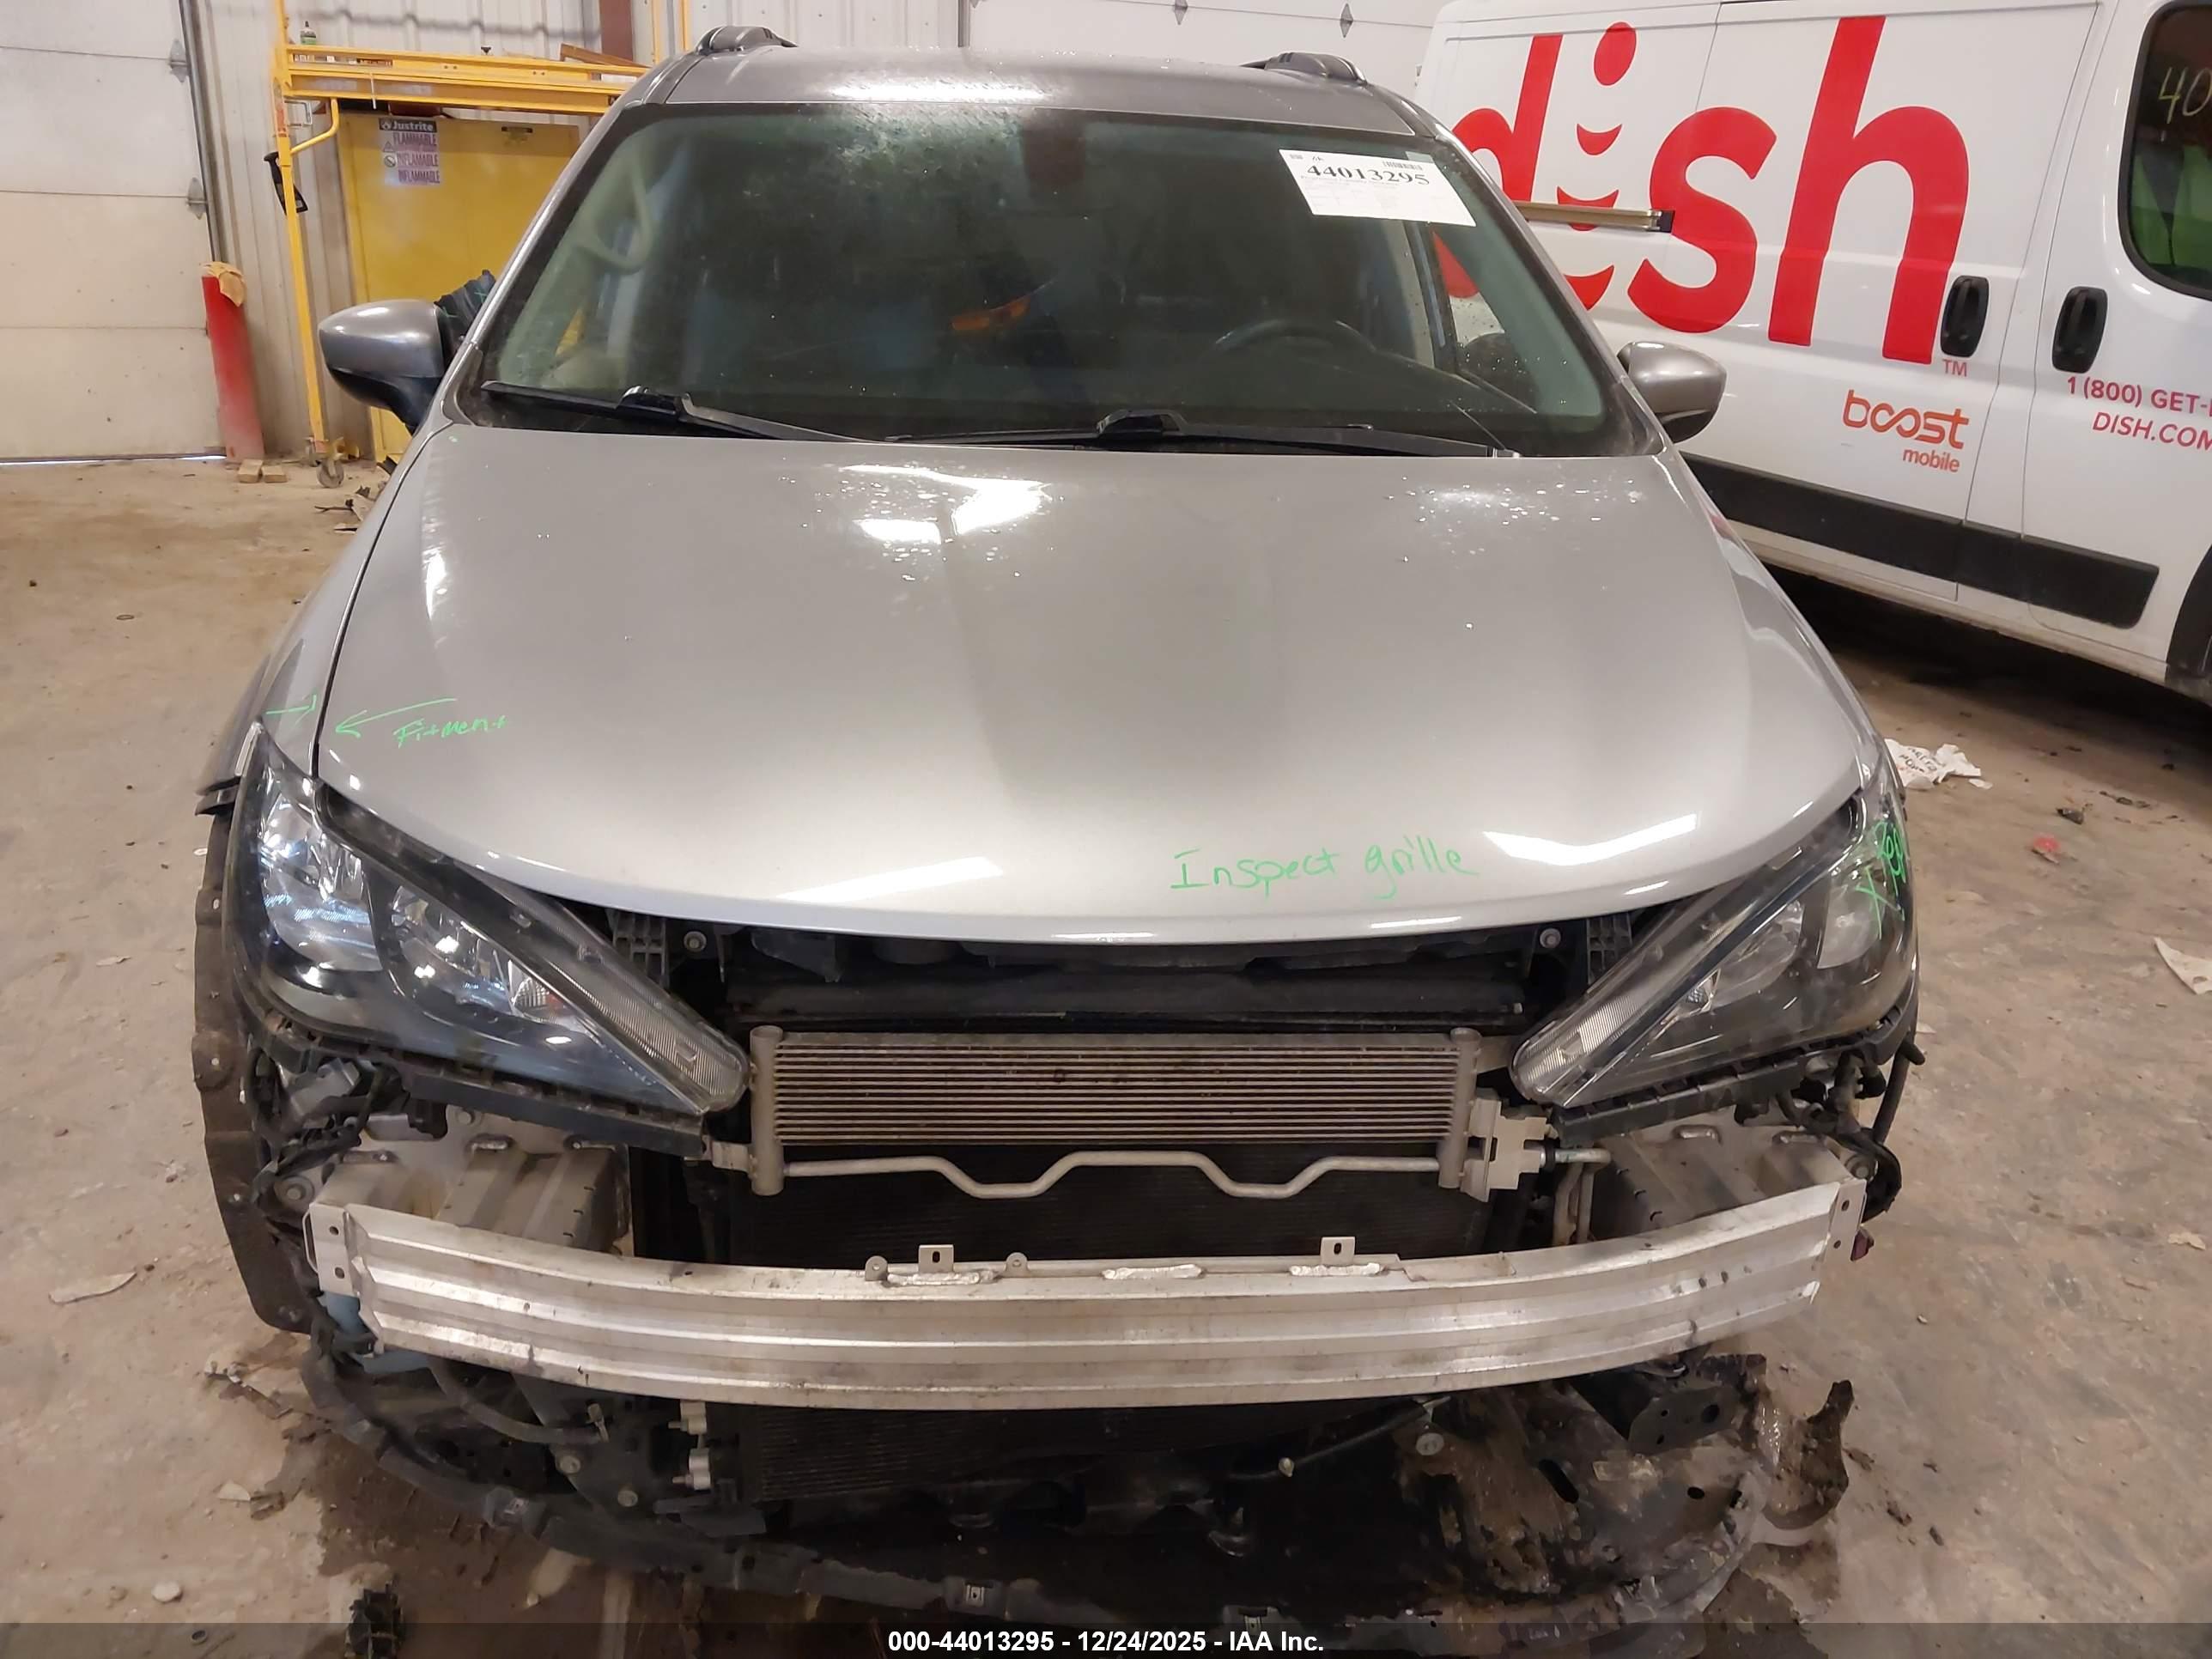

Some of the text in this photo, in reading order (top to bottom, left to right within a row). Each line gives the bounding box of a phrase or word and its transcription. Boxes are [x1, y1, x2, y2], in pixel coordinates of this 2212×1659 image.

[392, 120, 434, 131] Justrite
[392, 132, 437, 146] FLAMMABLE
[1307, 165, 1430, 185] 44013295
[1432, 17, 1970, 365] dish
[1943, 359, 1967, 377] TM
[2068, 376, 2076, 394] 1
[2083, 376, 2142, 408] (800)
[1843, 389, 1970, 450] boost
[1902, 447, 1960, 473] mobile
[1170, 835, 1480, 900] Inspect grille
